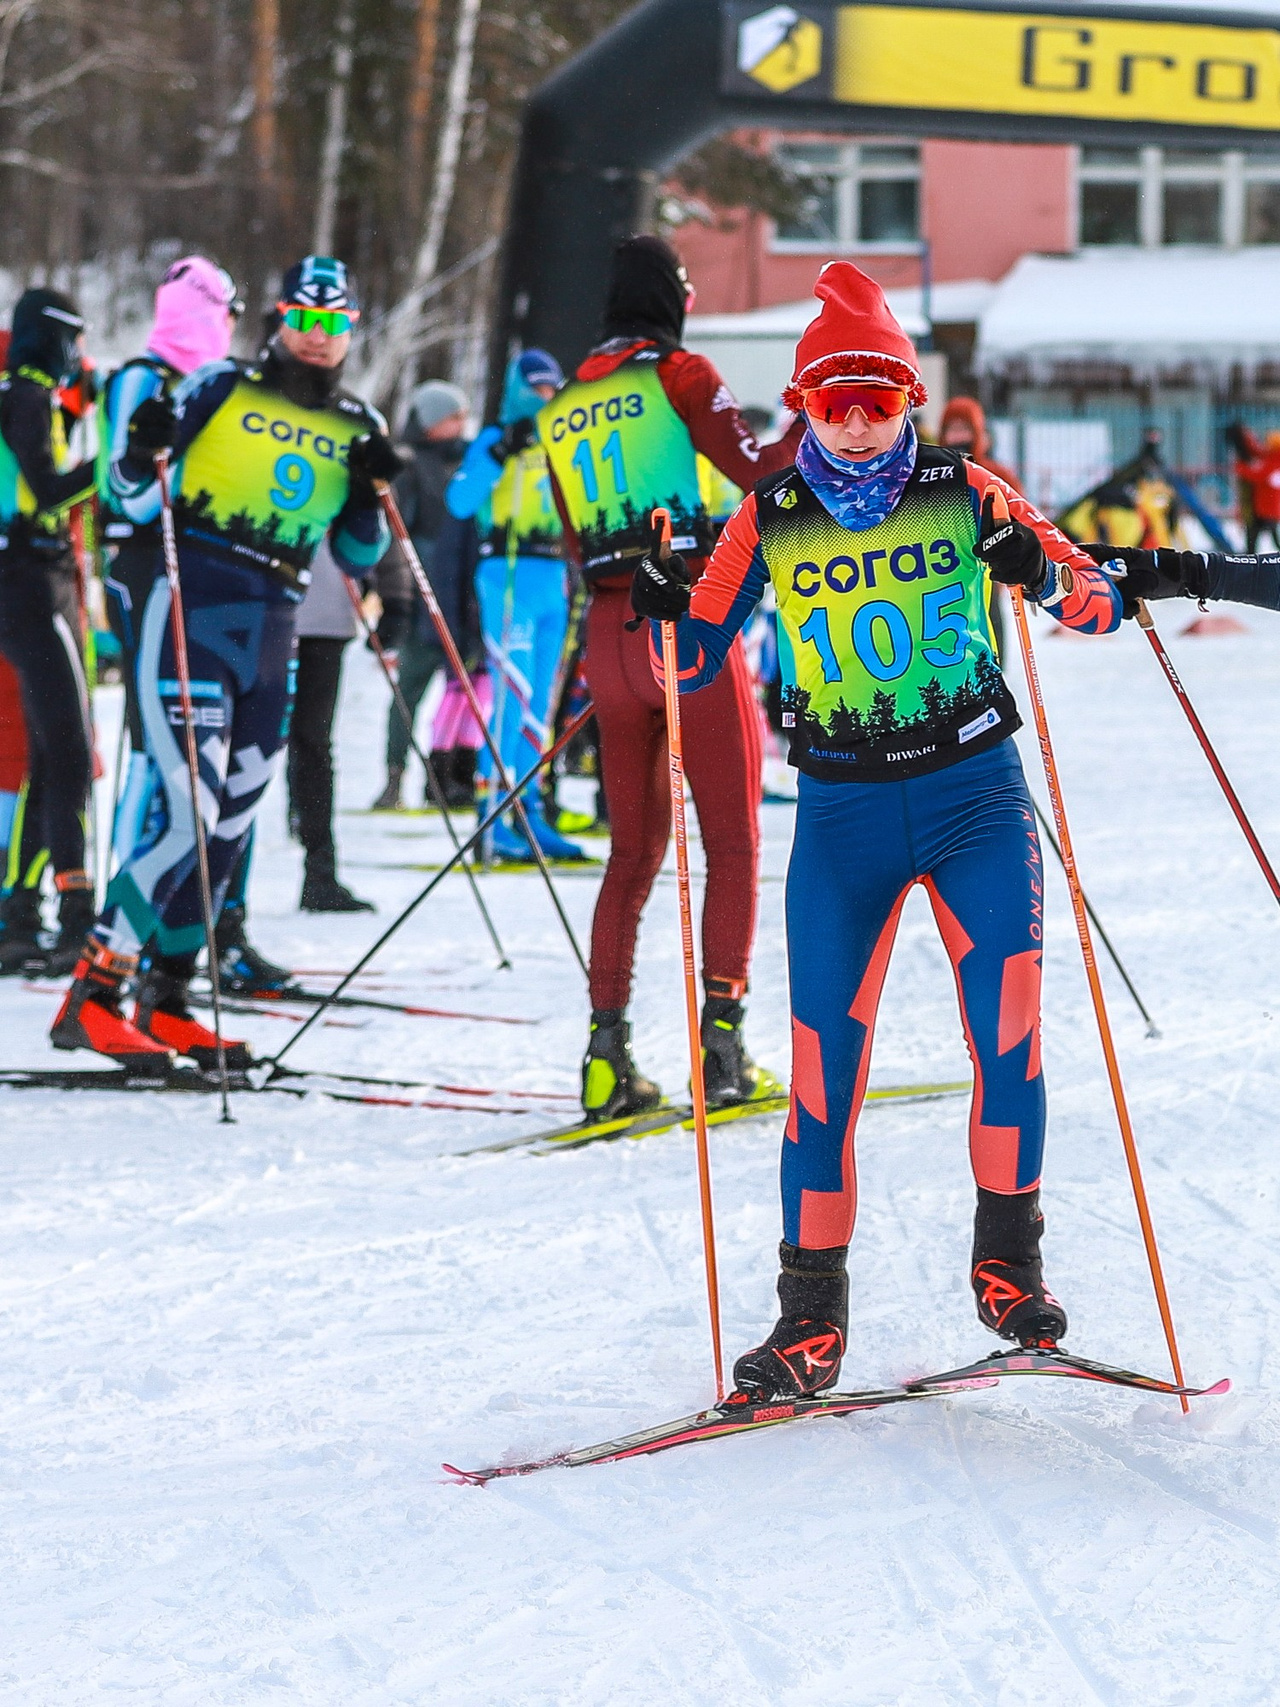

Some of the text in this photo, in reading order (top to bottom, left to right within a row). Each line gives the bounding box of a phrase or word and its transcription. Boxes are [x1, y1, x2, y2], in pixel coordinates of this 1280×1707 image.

[551, 393, 645, 443] согаз
[269, 452, 316, 511] 9
[571, 429, 629, 504] 11
[792, 538, 960, 598] согаз
[799, 581, 973, 684] 105
[885, 743, 937, 763] DIWARI
